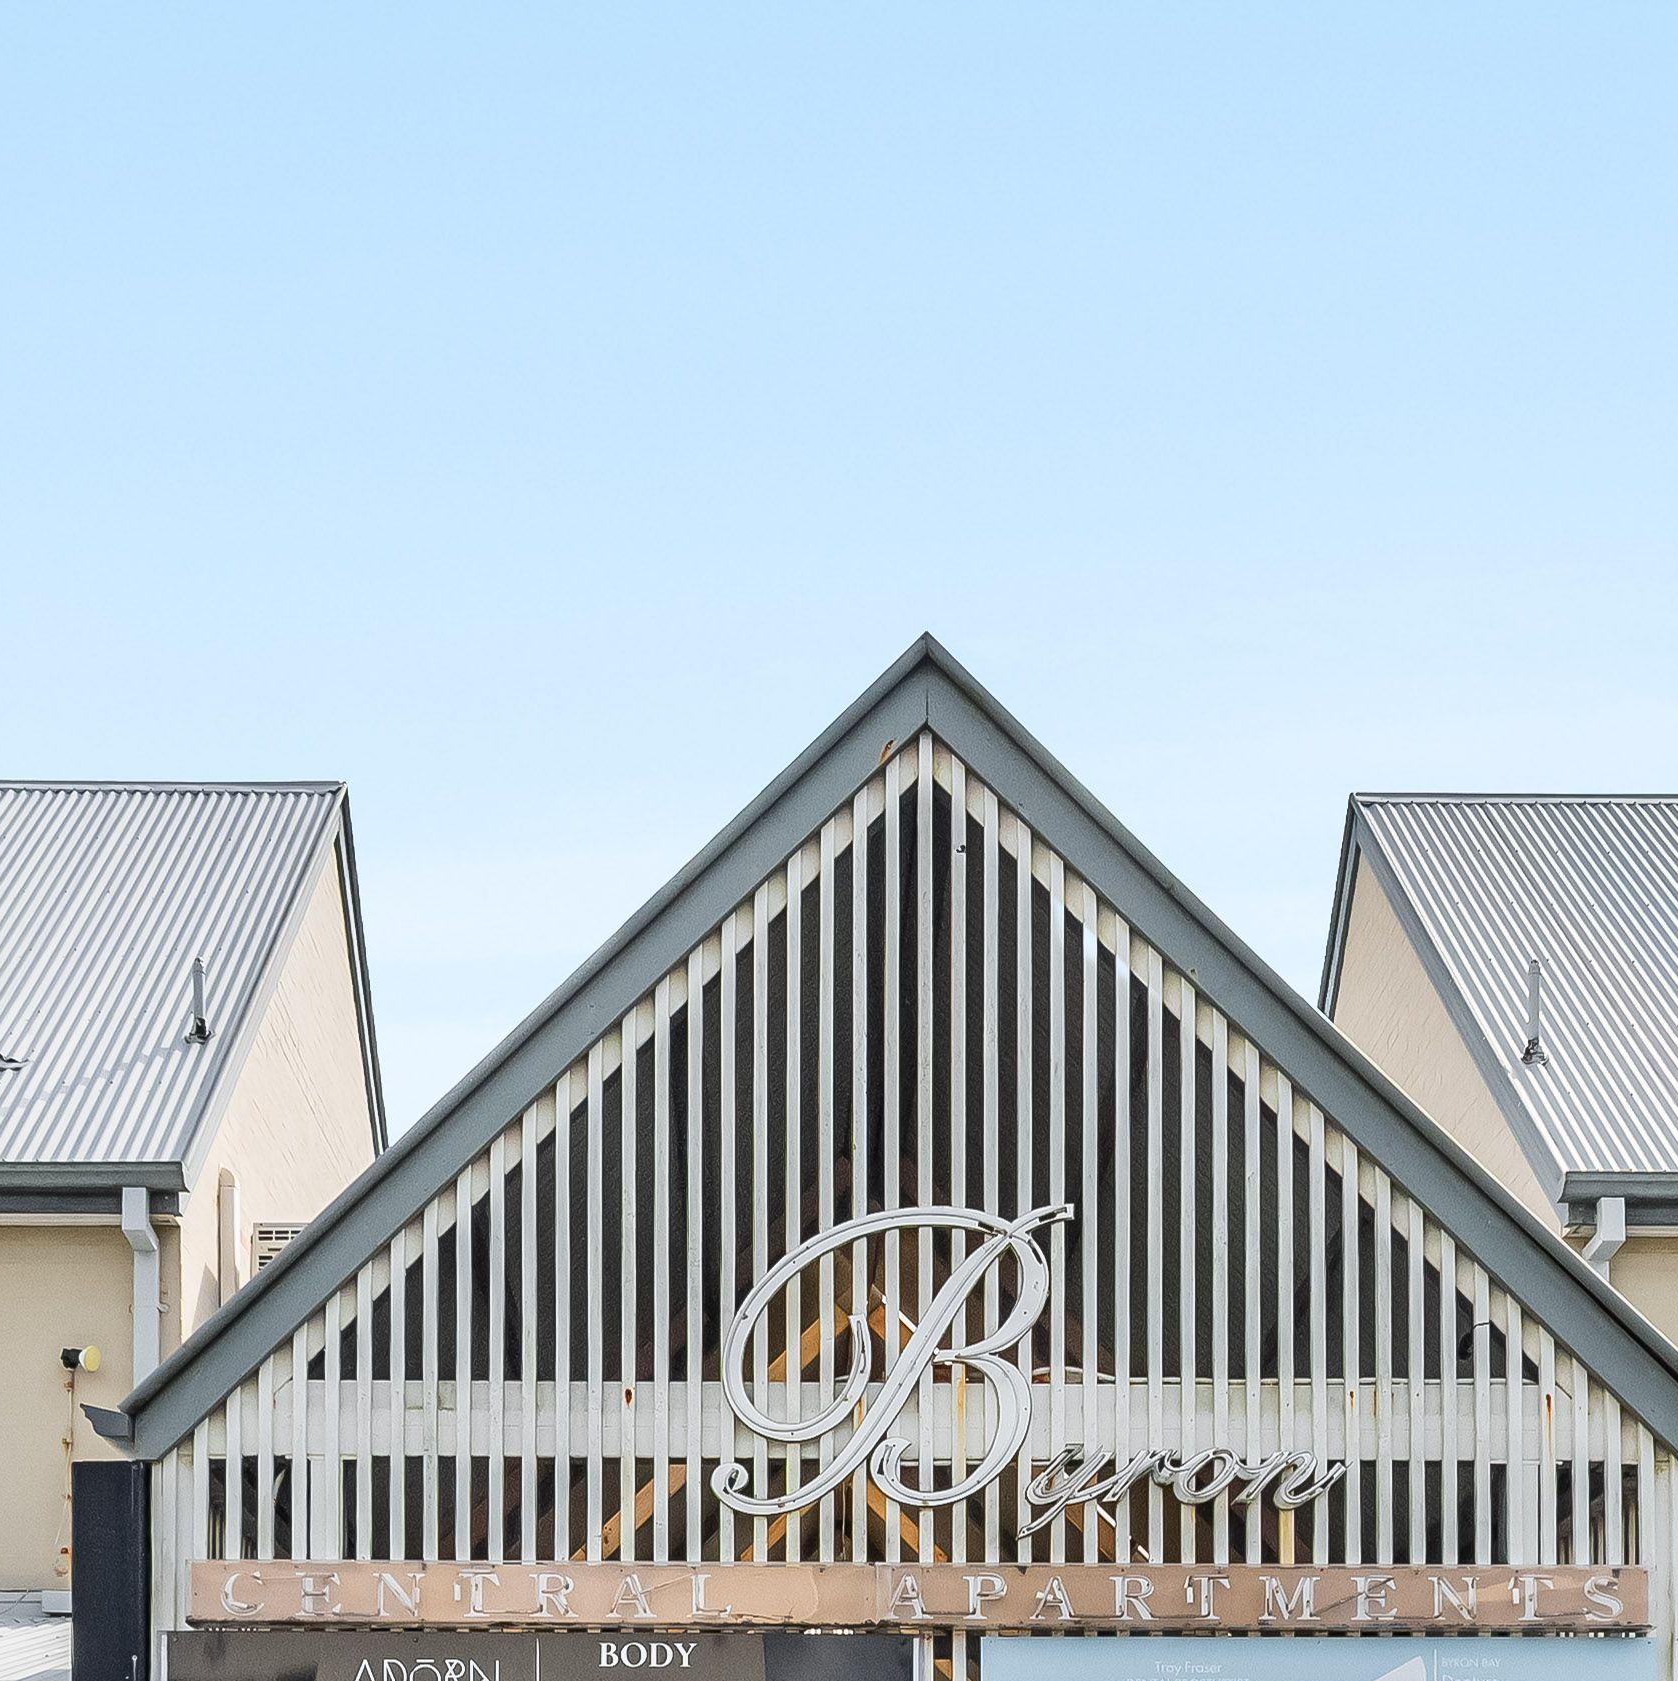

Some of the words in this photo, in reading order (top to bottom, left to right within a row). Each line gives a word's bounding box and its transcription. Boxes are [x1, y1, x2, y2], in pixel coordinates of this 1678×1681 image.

[711, 1203, 1352, 1540] Byron
[221, 1570, 733, 1618] CENTRAL
[889, 1572, 1624, 1621] APARTMENTS
[598, 1642, 698, 1668] BODY
[1154, 1660, 1182, 1676] Troy
[1184, 1660, 1223, 1674] Fraser
[1440, 1657, 1479, 1668] BYRON
[1482, 1657, 1501, 1668] BAY
